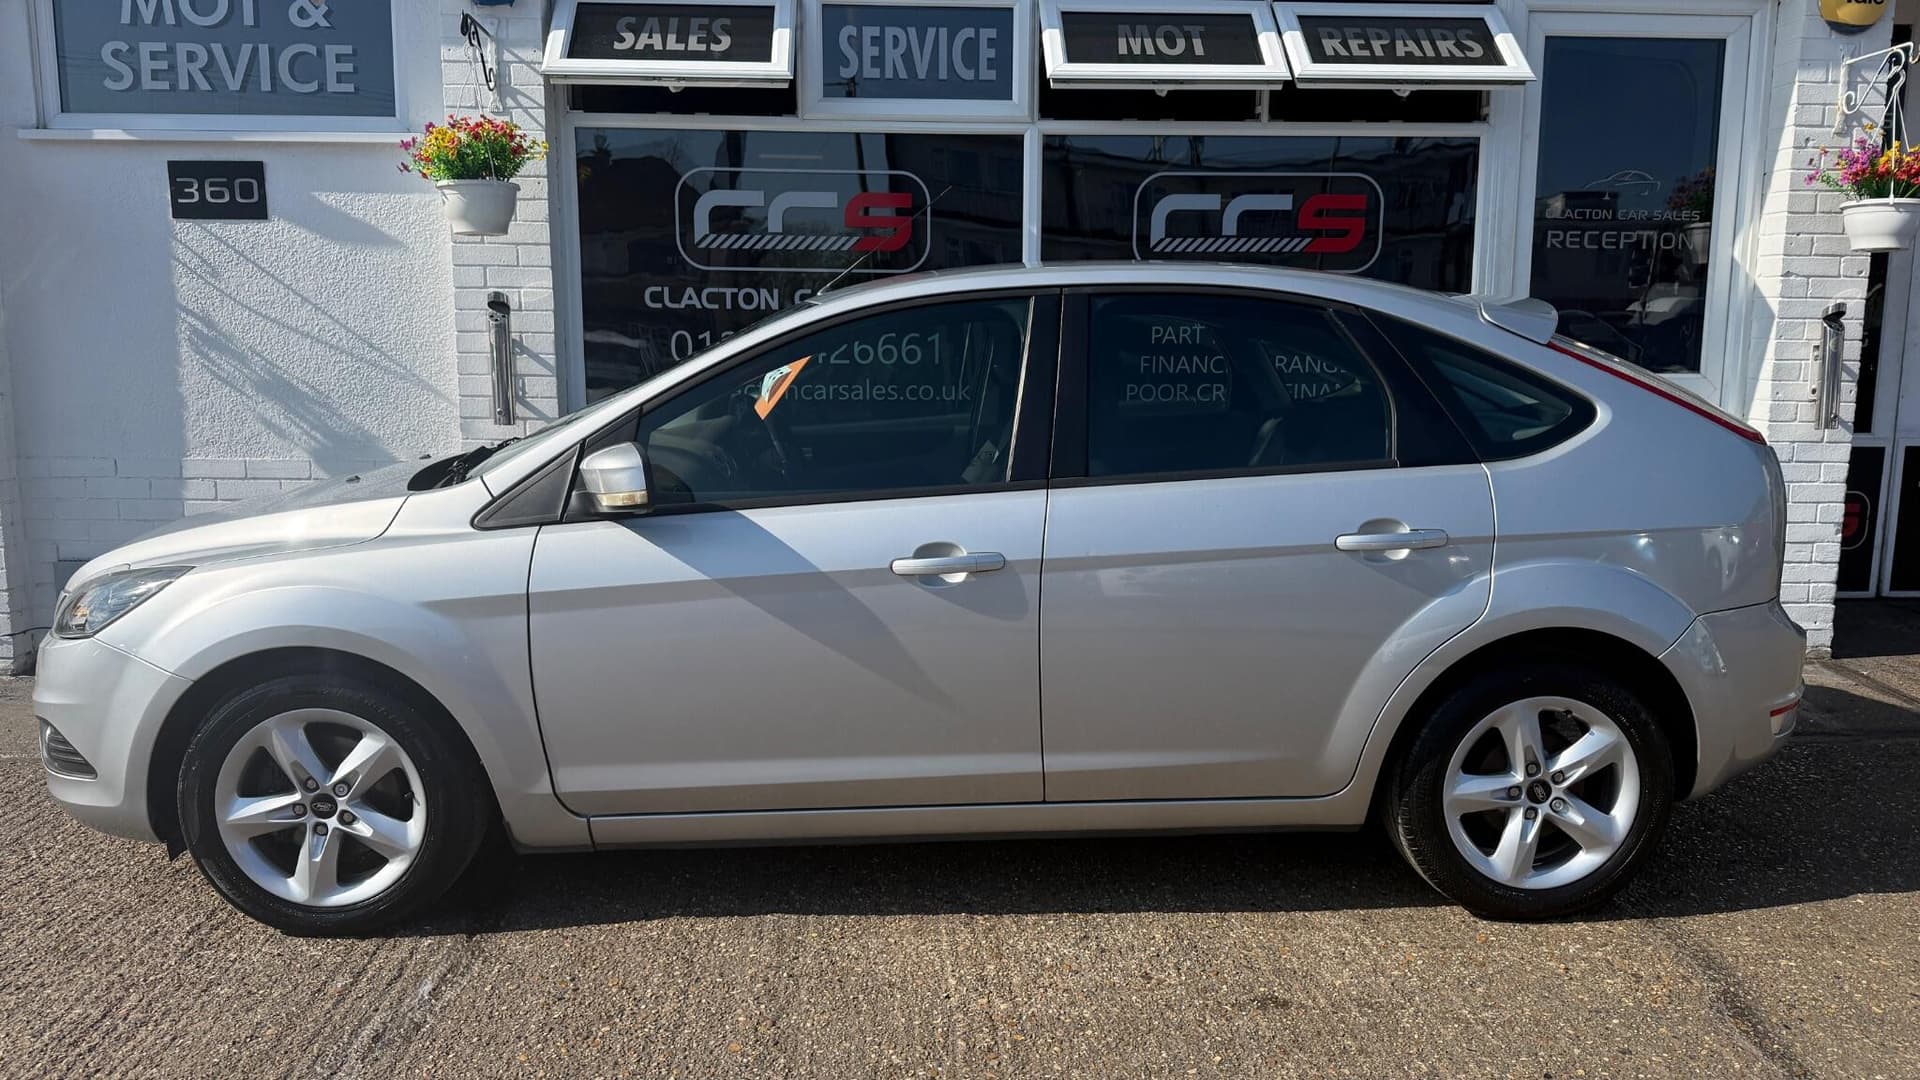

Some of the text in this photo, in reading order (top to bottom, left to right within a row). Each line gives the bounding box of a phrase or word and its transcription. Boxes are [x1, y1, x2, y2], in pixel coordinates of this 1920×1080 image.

[613, 15, 732, 53] SALES
[1117, 24, 1206, 56] MOT
[1321, 26, 1484, 59] REPAIRS
[838, 25, 998, 81] SERVICE
[101, 41, 355, 93] SERVICE
[175, 177, 260, 205] 360
[1545, 208, 1701, 222] CLACTON CAR SALES
[1546, 230, 1697, 250] RECEPTION
[644, 286, 779, 310] CLACTON
[1151, 325, 1206, 345] PART
[1140, 355, 1229, 374] FINANC
[1126, 383, 1189, 402] POOR
